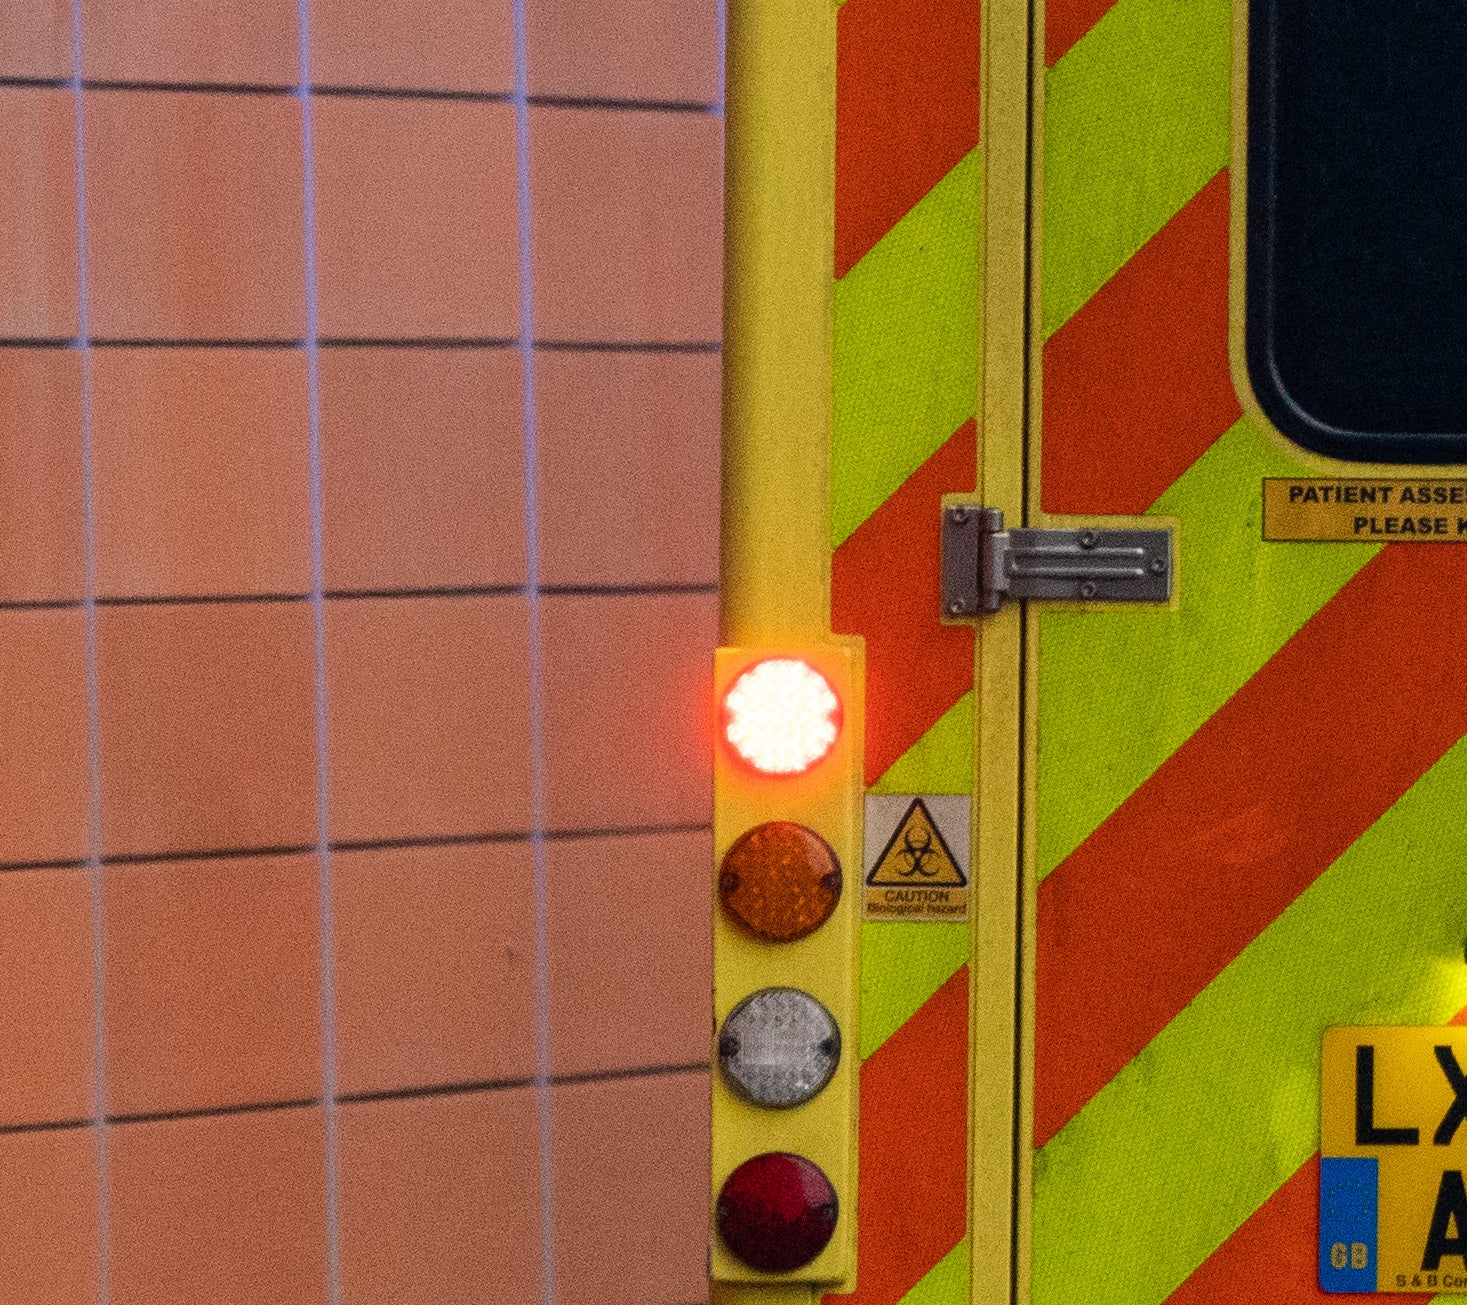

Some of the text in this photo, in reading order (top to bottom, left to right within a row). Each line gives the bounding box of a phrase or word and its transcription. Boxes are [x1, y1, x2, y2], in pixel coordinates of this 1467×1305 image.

[1289, 486, 1394, 504] PATIENT
[1353, 516, 1448, 535] PLEASE
[885, 890, 950, 902] CAUTION
[1331, 1242, 1368, 1270] GB
[1411, 1274, 1421, 1288] &
